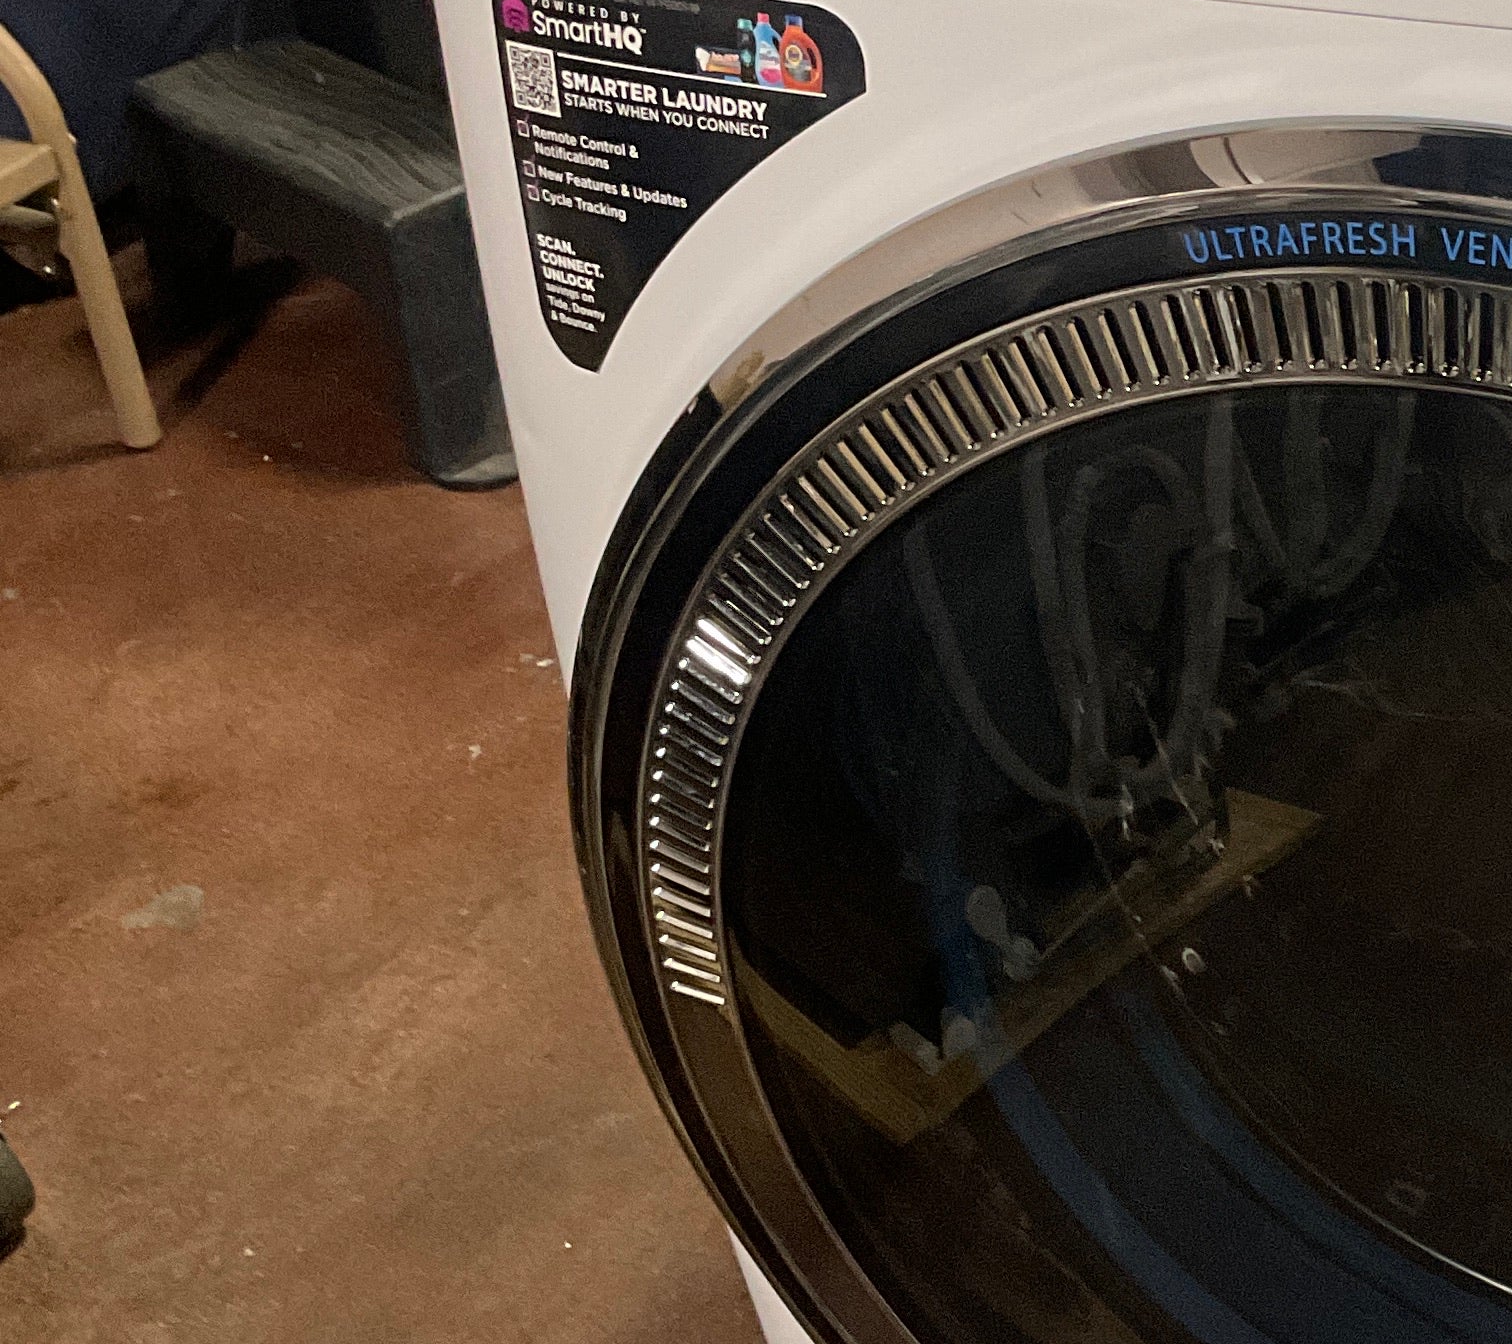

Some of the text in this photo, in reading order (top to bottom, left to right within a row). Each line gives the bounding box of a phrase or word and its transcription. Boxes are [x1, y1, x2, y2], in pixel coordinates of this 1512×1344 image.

[620, 10, 640, 24] BY
[560, 70, 768, 121] SMARTER LAUNDRY
[564, 92, 770, 139] STARTS WHEN YOU CONNECT
[531, 124, 639, 159] Remote Control &
[534, 141, 610, 170] Notifications
[537, 164, 688, 209] New Features & Updates
[541, 188, 627, 223] Cycle Tracking
[536, 233, 576, 256] SCAN.
[1181, 220, 1417, 265] ULTRAFRESH
[539, 250, 604, 279] CONNECT.
[542, 265, 596, 293] UNLOCK
